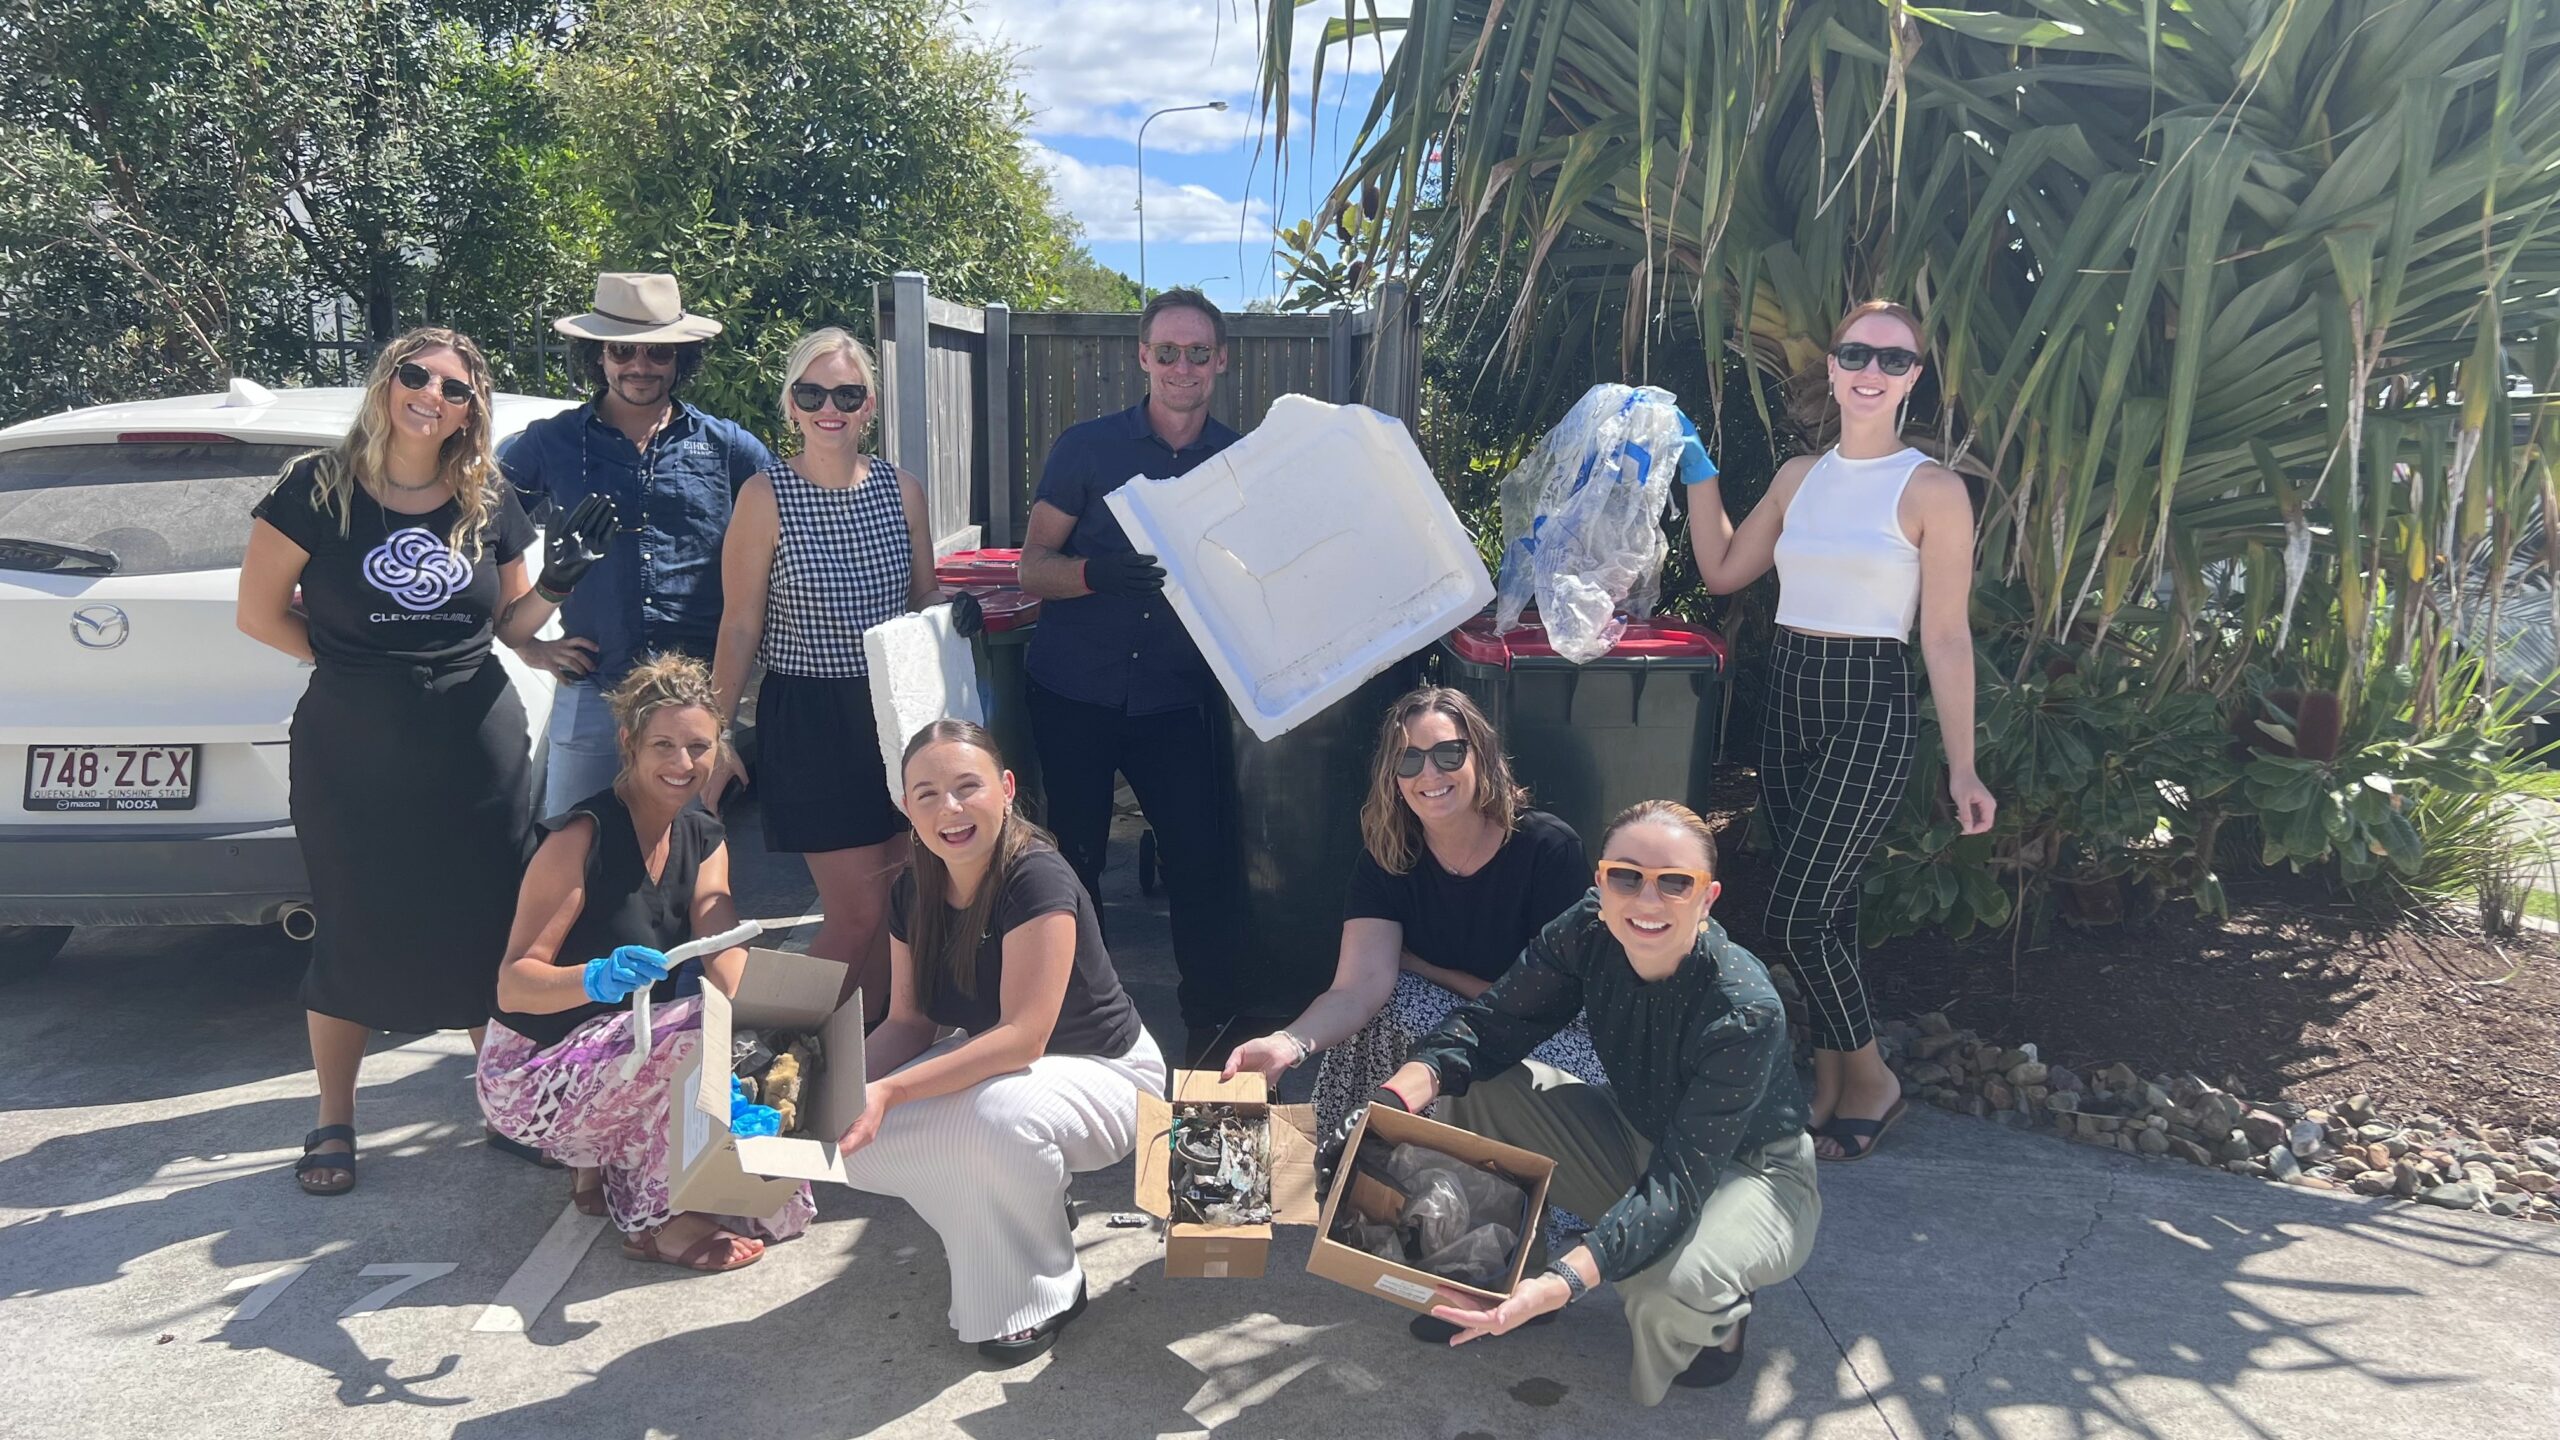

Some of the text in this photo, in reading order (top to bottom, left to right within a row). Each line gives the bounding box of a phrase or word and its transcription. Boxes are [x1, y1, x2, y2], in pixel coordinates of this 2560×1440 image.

[33, 789, 97, 798] QUEENSLAND
[107, 789, 152, 798] SUNSHINE
[158, 789, 188, 798] STATE
[116, 800, 159, 810] NOOSA
